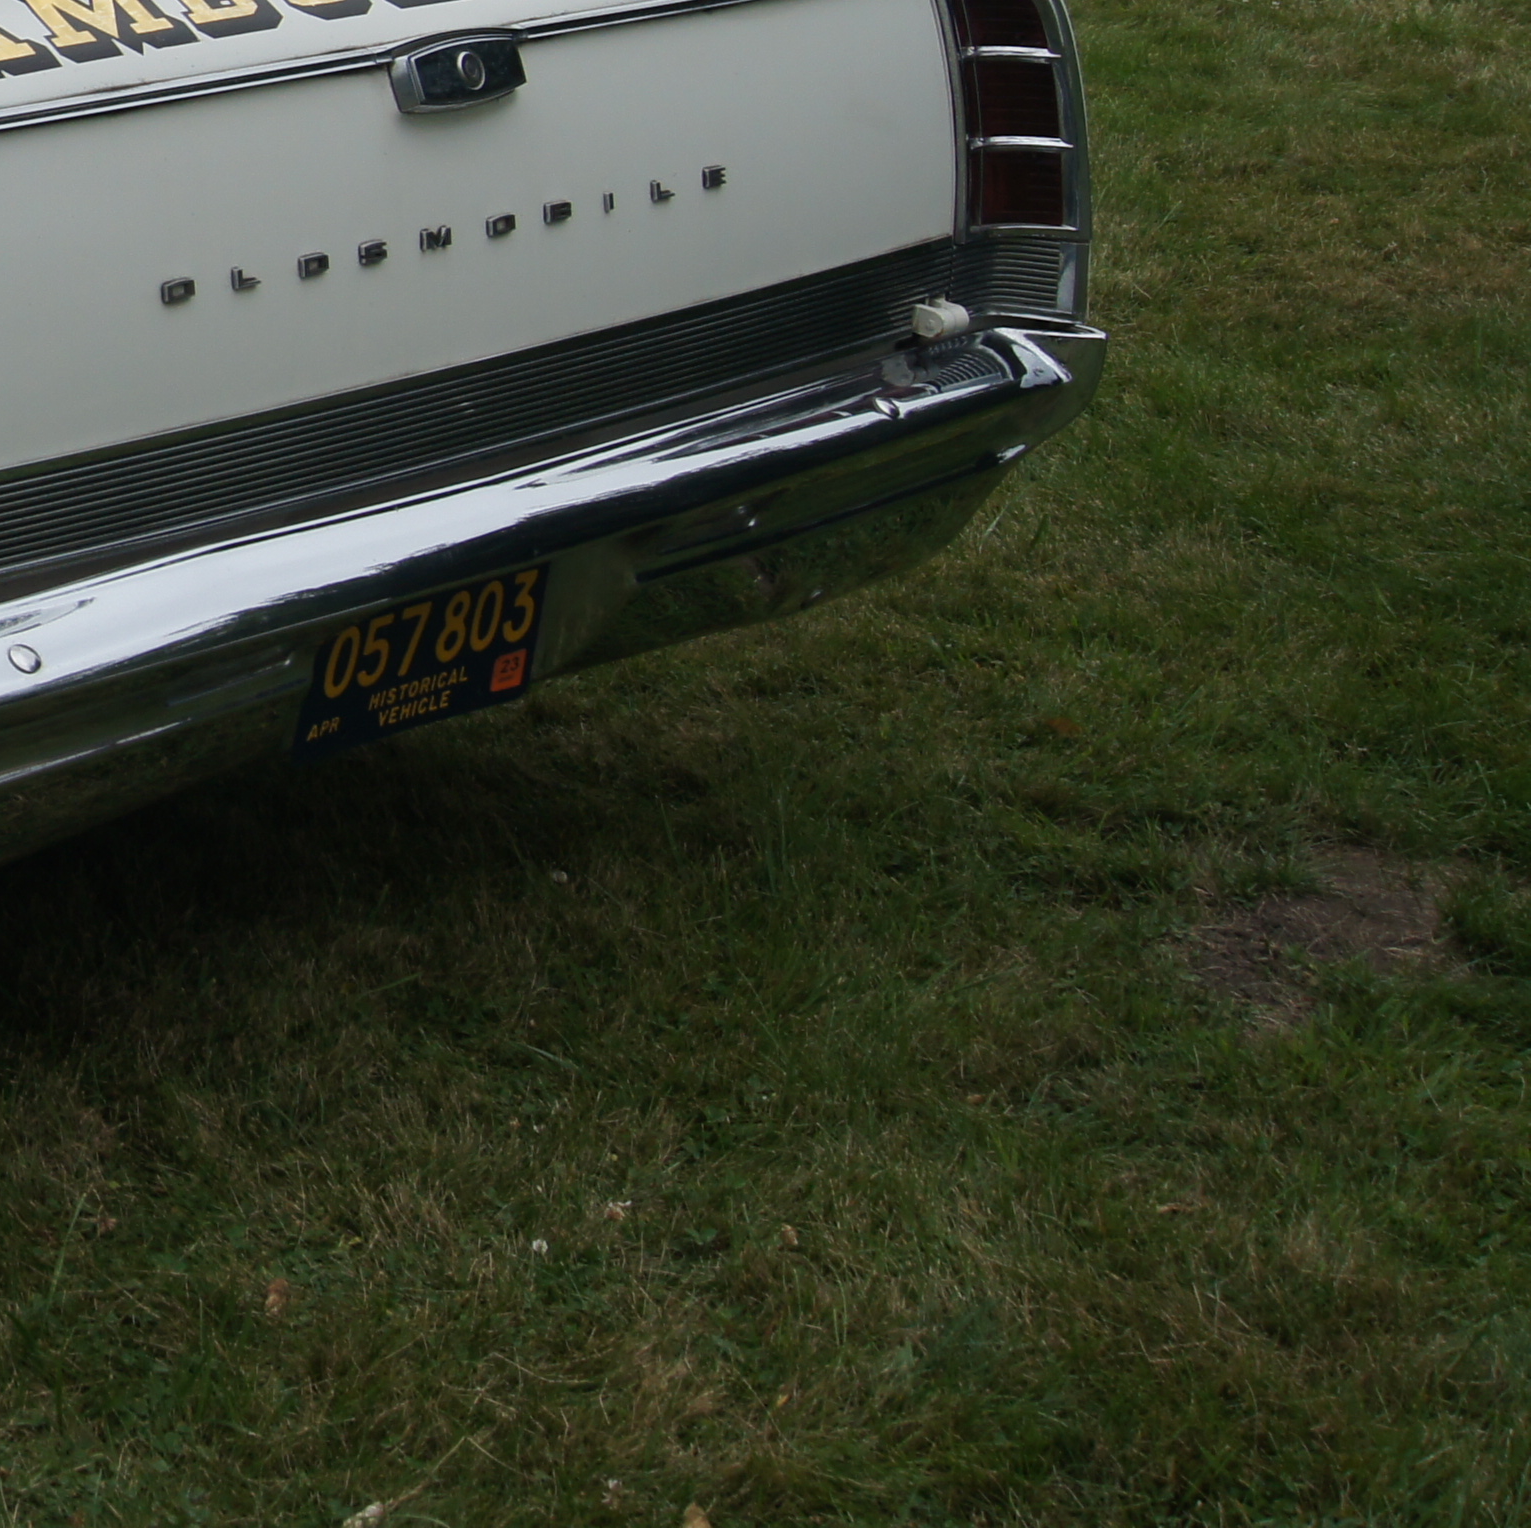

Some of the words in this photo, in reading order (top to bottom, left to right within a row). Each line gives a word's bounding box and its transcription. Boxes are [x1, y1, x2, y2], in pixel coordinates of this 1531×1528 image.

[161, 163, 727, 304] OLDSMOBILE
[500, 656, 519, 673] 23
[369, 666, 468, 711] HISTORICAL
[378, 690, 451, 727] VEHICLE
[306, 716, 341, 741] APR
